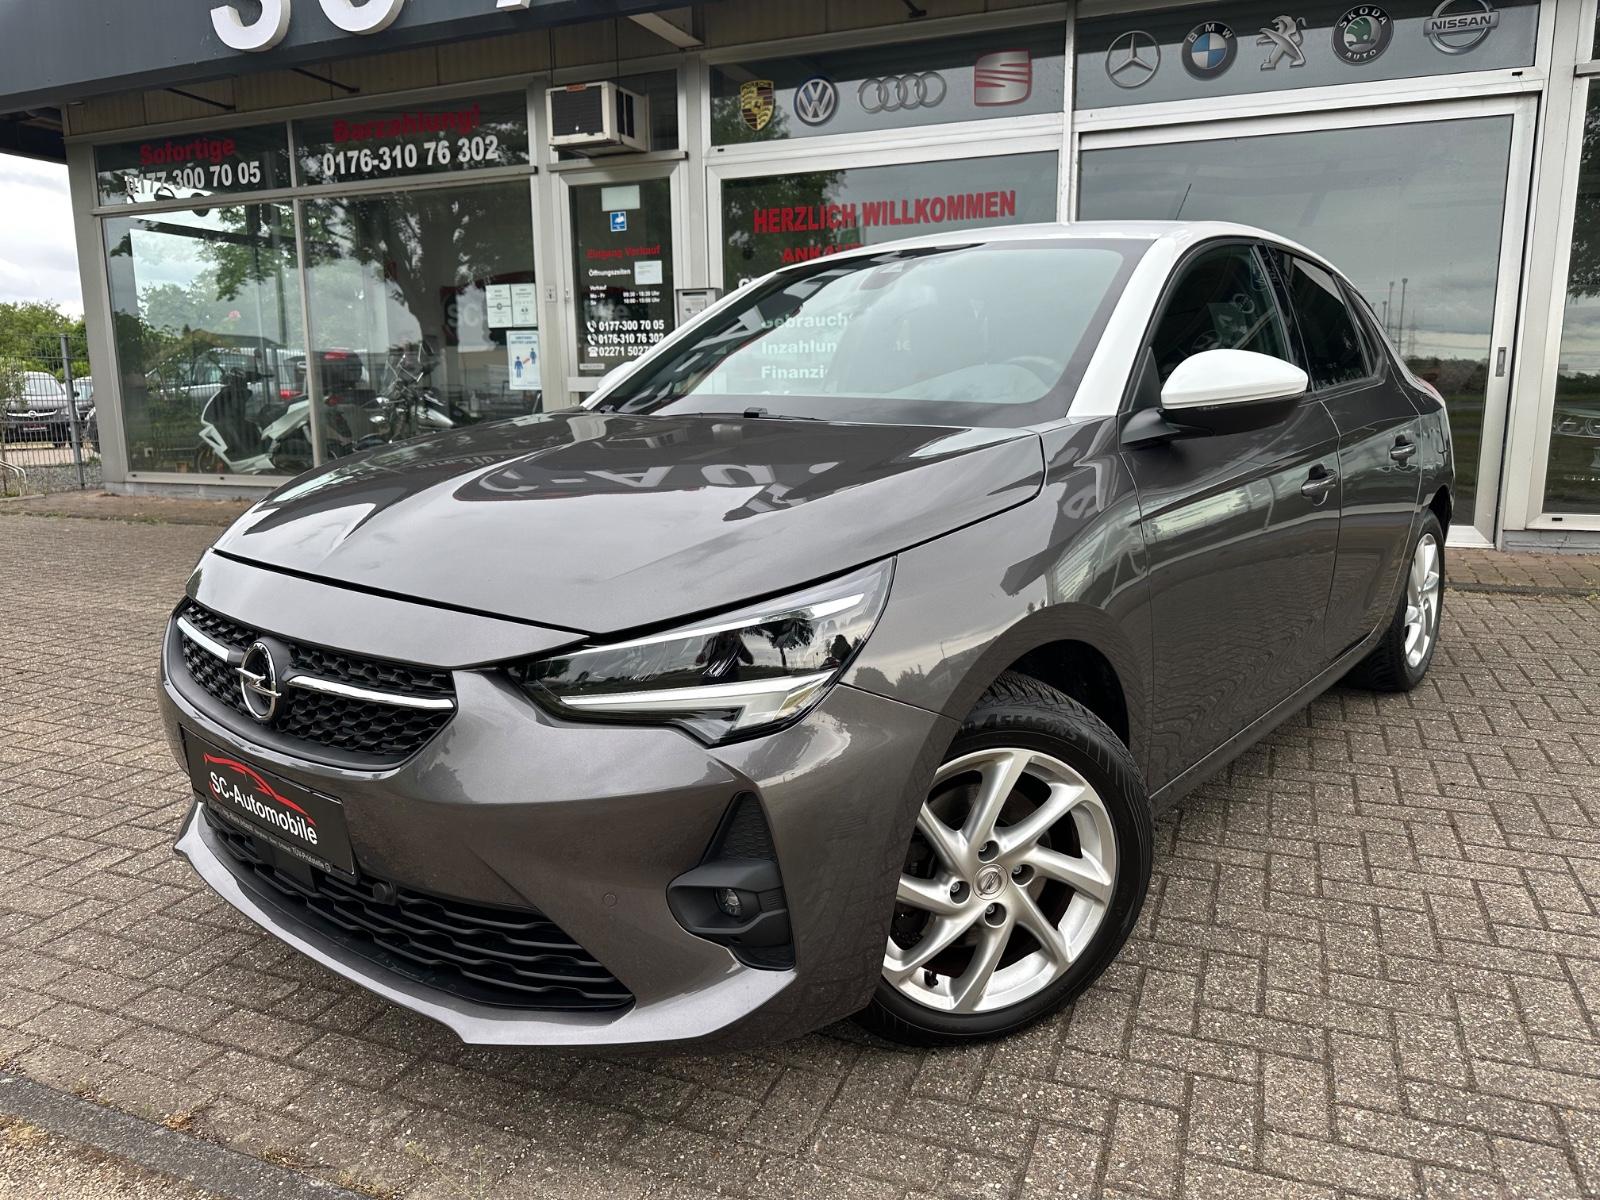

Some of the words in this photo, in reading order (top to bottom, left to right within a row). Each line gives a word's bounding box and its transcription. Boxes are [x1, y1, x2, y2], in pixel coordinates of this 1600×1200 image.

[1430, 14, 1492, 31] NISSAN
[1187, 22, 1233, 44] BMW
[1345, 49, 1377, 60] AUTO
[333, 106, 481, 143] Barzahlung!
[139, 138, 236, 166] Sofortige
[323, 143, 418, 176] 0176-310
[424, 140, 451, 167] 76
[458, 135, 499, 163] 302
[126, 167, 205, 196] 0177-300
[209, 164, 233, 188] 70
[238, 161, 261, 185] 05
[753, 202, 857, 234] HERZLICH
[862, 190, 1016, 227] WILLKOMMEN
[625, 244, 660, 256] Verkauf
[588, 268, 631, 278] Öffnungszeiten
[598, 320, 638, 331] 0177-300
[640, 319, 651, 330] 70
[653, 319, 665, 330] 05
[598, 333, 635, 344] 0176-310
[636, 332, 647, 344] 76
[649, 332, 665, 344] 302
[598, 346, 625, 357] 02271
[627, 345, 652, 356] 5027
[762, 339, 838, 355] Inzahlun
[209, 771, 318, 845] SC-Automobile
